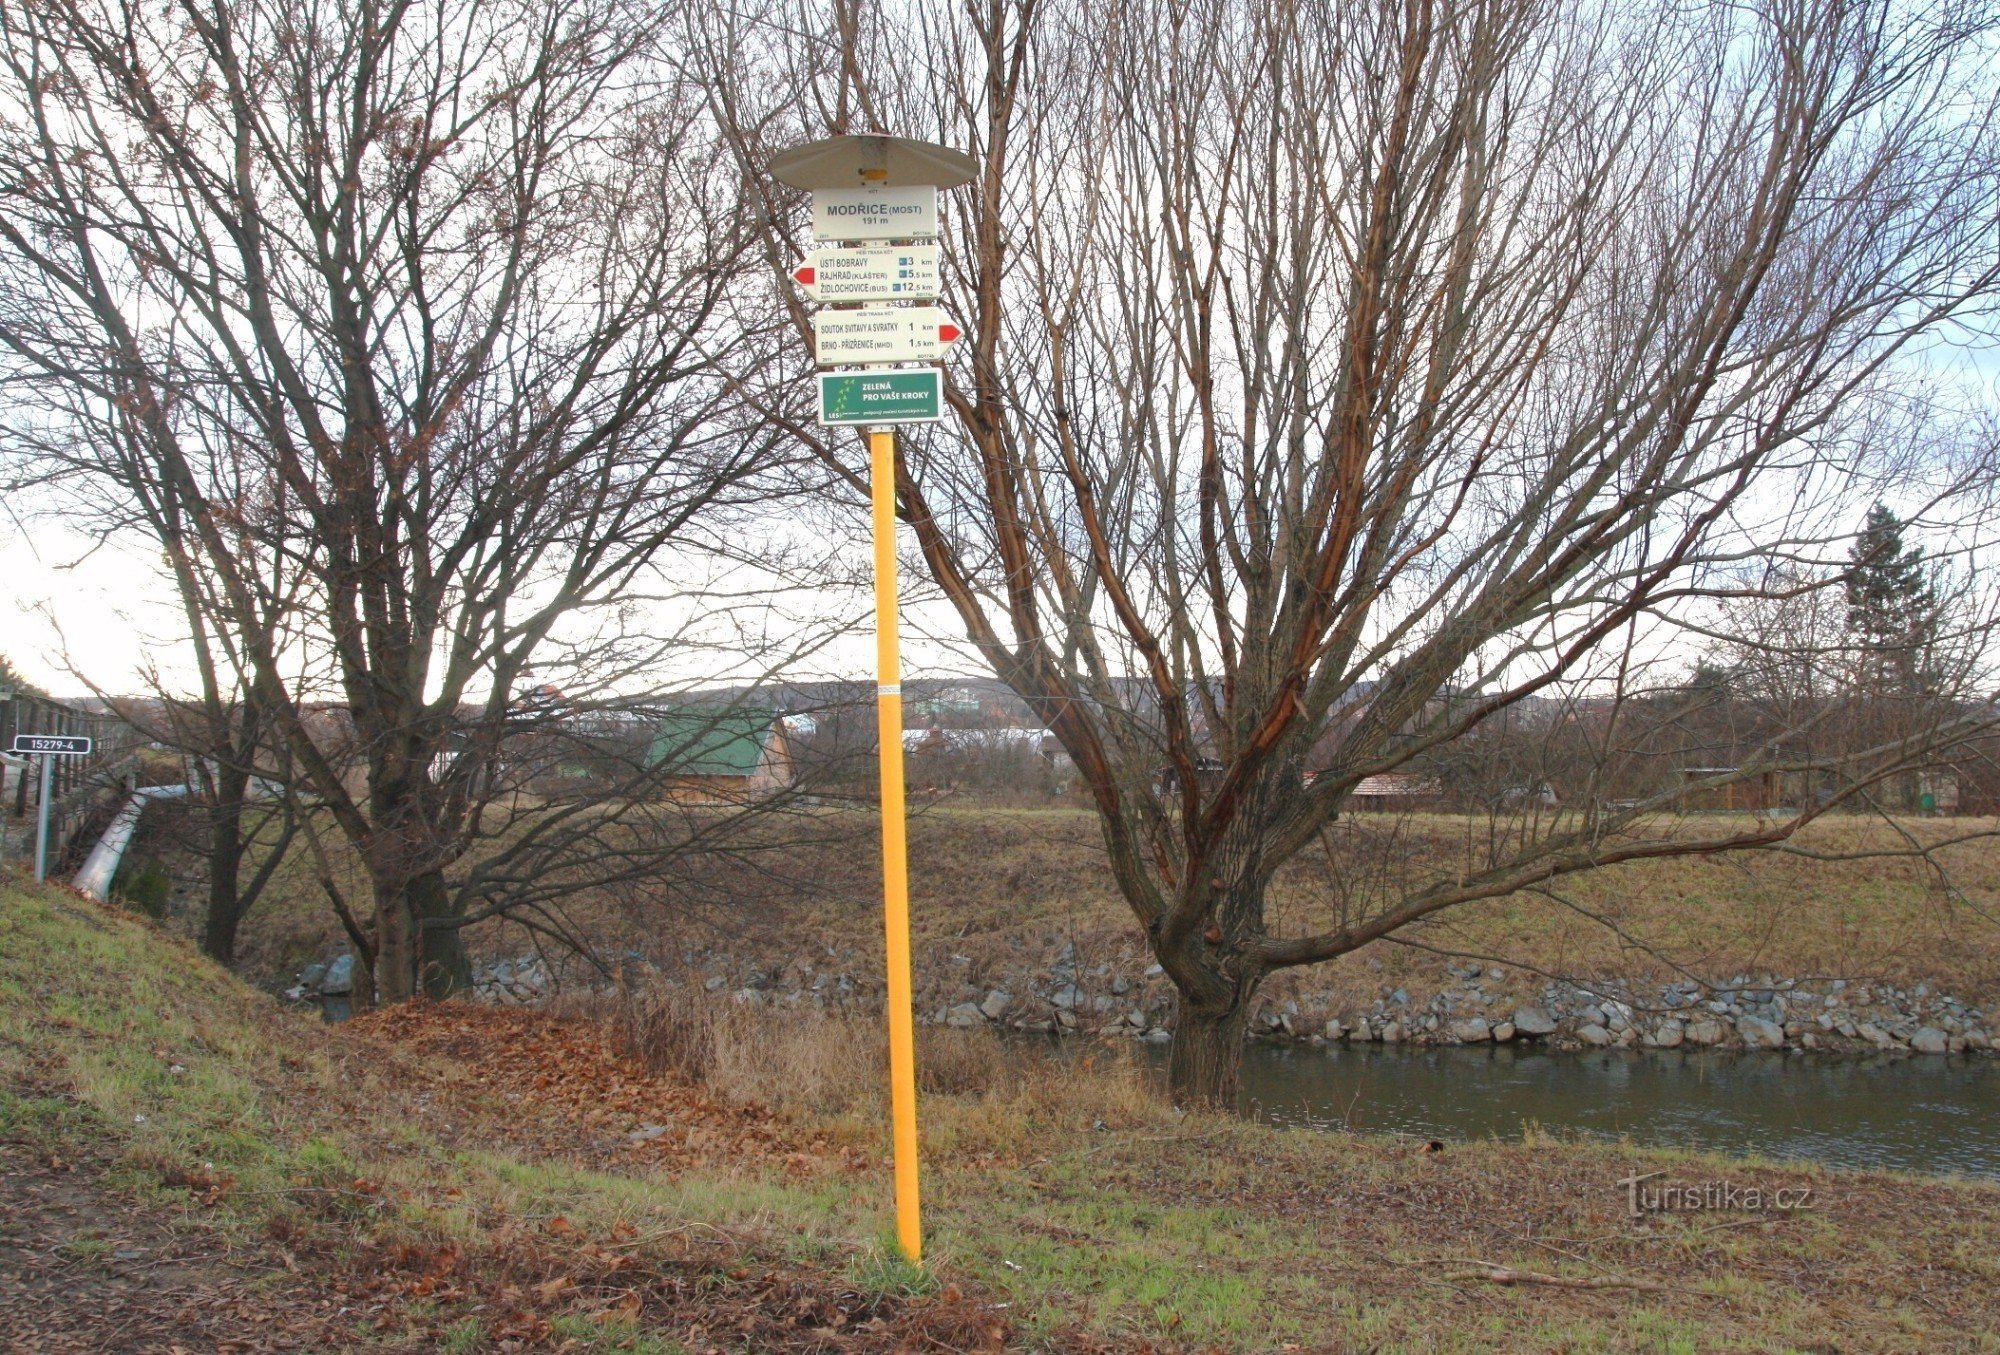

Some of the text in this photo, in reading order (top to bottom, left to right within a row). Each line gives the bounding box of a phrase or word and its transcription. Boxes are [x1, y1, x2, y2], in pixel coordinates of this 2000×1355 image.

[827, 202, 922, 216] MODŘICE (MOST)
[863, 217, 877, 225] 191
[820, 257, 835, 268] ÚSTÍ
[836, 258, 868, 268] BOBRAVY
[908, 257, 914, 266] 3
[820, 271, 851, 280] RAJHRAD
[908, 270, 920, 278] 5,5
[820, 283, 869, 293] ŽIDLOCHOVICE
[869, 285, 888, 293] (BUS)
[902, 283, 920, 292] 12,5
[820, 325, 844, 334] SOUTOK
[844, 324, 867, 333] SVITAVY
[868, 323, 872, 331] A
[872, 323, 898, 332] SVRATKY
[909, 322, 914, 331] 1
[821, 341, 838, 350] BRNO
[874, 342, 893, 350] (MHD)
[909, 339, 921, 348] 1,5
[862, 382, 892, 391] ZELENÁ
[863, 391, 929, 401] PRO VAŠE KROKY
[31, 740, 74, 750] 15279-4
